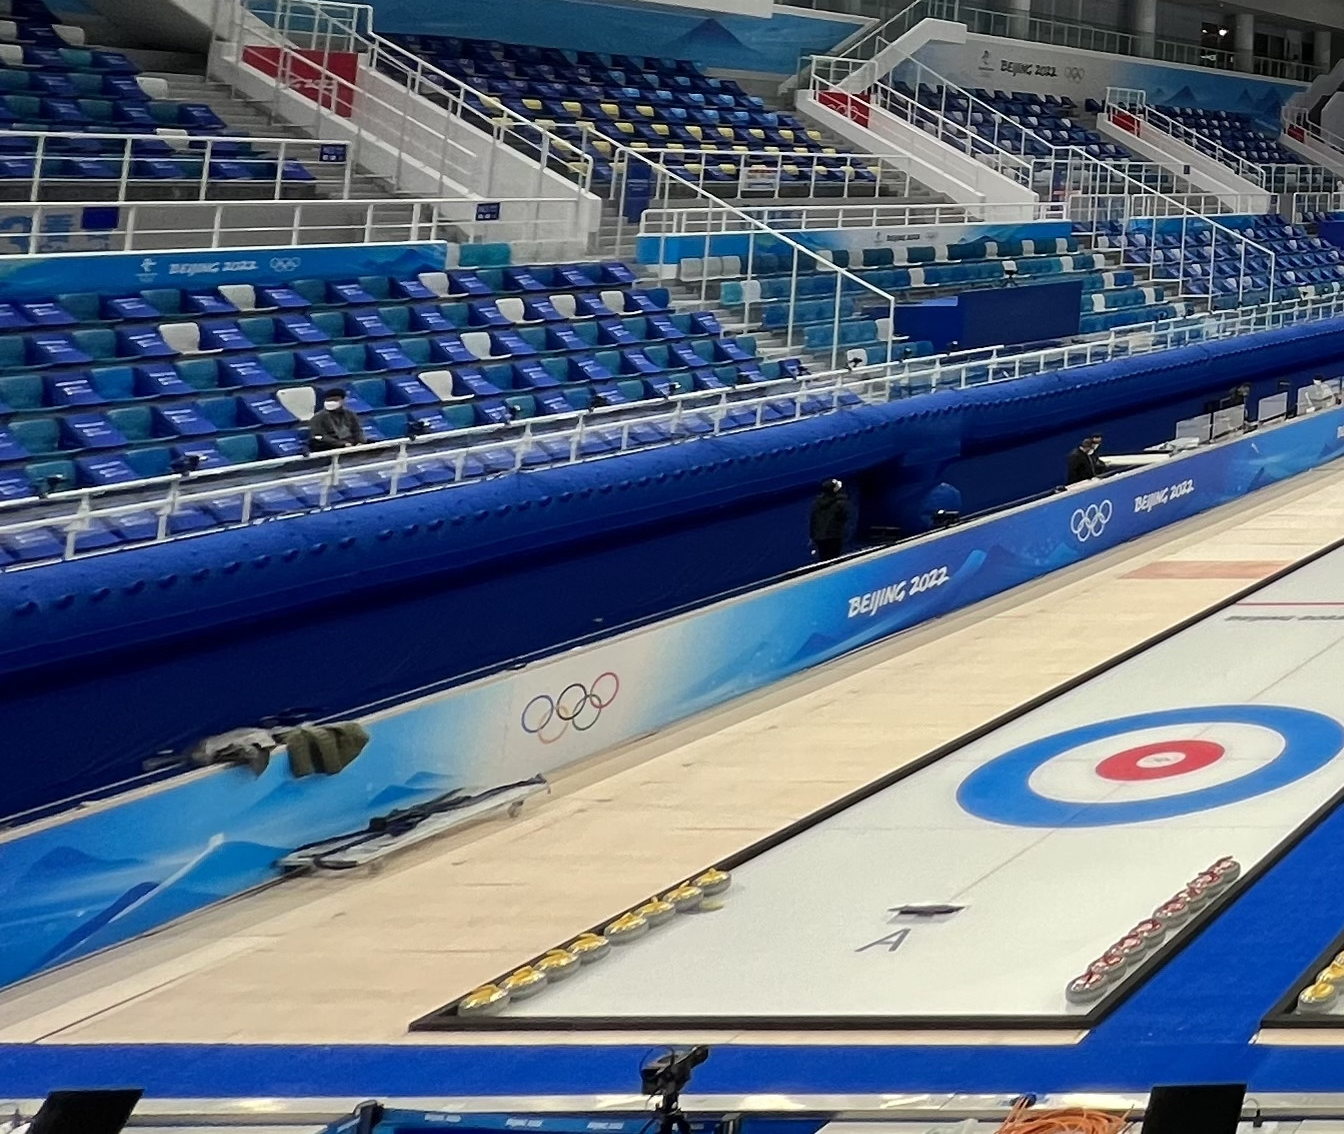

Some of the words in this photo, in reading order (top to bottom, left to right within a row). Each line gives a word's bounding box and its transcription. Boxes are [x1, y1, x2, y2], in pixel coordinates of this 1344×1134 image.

[1000, 59, 1033, 77] BEIJING
[1035, 64, 1058, 77] 2022
[1133, 487, 1169, 513] BEIJING
[1169, 478, 1195, 500] 2022
[847, 580, 907, 619] BEIJING
[908, 565, 951, 596] 2022
[854, 927, 912, 953] A
